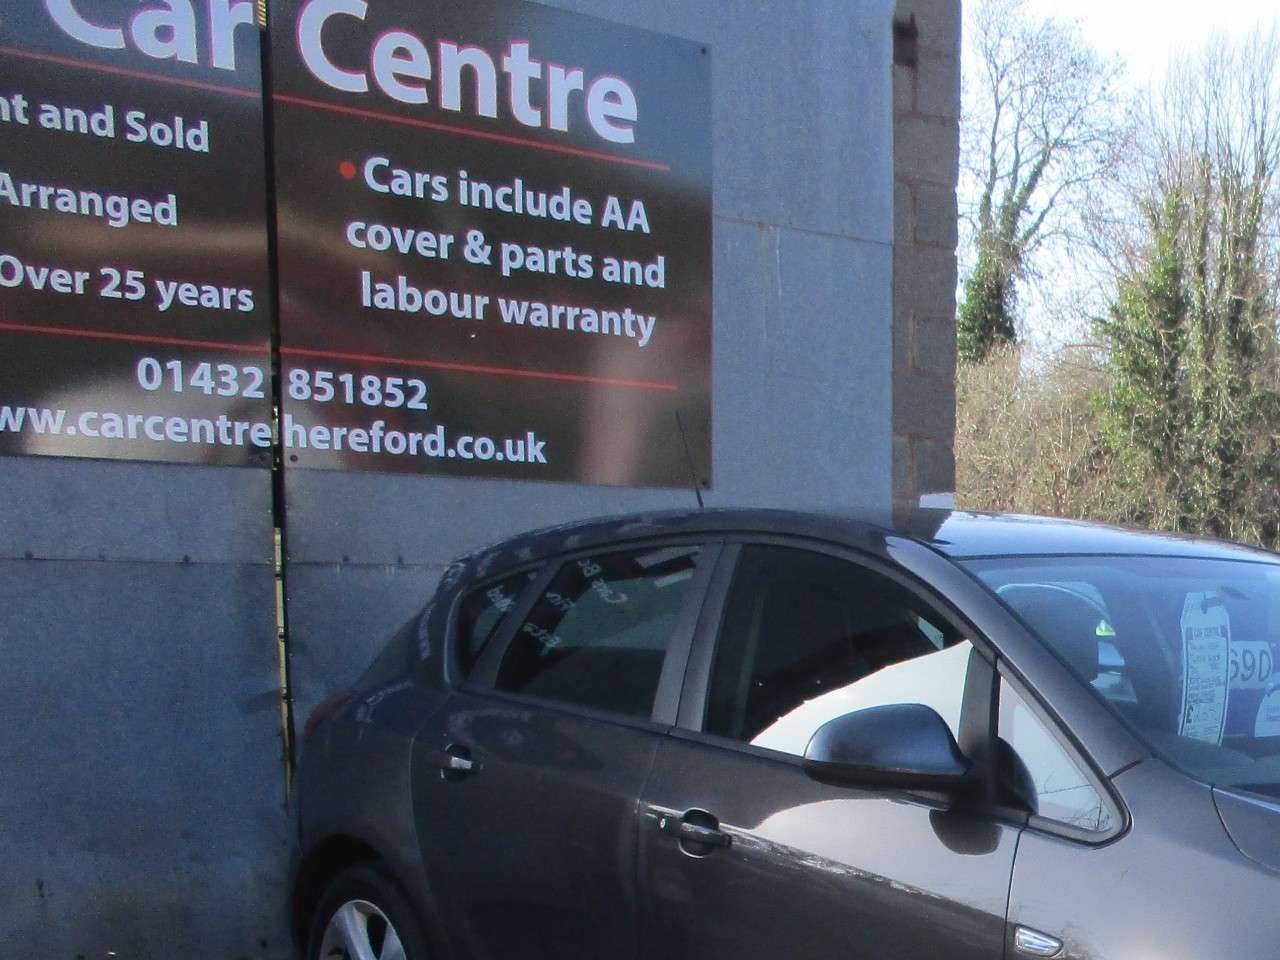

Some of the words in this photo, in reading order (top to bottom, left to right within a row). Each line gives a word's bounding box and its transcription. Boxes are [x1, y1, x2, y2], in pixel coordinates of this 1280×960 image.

[297, 0, 638, 144] Centre
[38, 102, 116, 138] and
[125, 110, 210, 153] Sold
[363, 156, 449, 202] Cars
[458, 170, 593, 225] include
[601, 196, 651, 235] AA
[0, 254, 90, 295] Over
[99, 267, 147, 300] 25
[155, 278, 256, 312] years
[345, 217, 454, 263] cover
[463, 227, 492, 266] &
[500, 241, 593, 279] parts
[602, 255, 666, 289] and
[361, 271, 489, 322] labour
[498, 299, 657, 348] warranty
[136, 356, 266, 399] 01432
[287, 367, 429, 410] 851852
